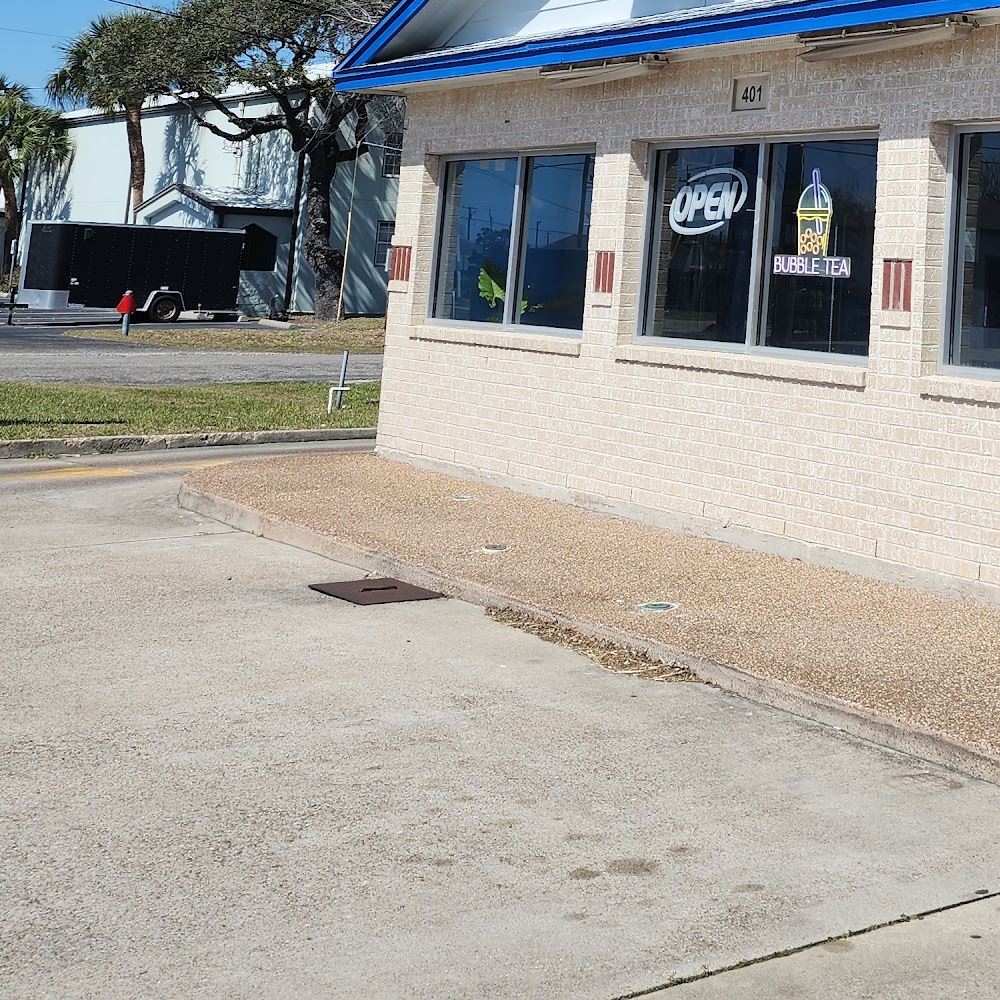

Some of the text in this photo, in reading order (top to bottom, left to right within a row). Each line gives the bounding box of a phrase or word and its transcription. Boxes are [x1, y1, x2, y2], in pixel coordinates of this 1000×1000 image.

[742, 85, 762, 103] 401
[674, 181, 739, 222] OPEN
[773, 256, 849, 276] BUBBLE TEA
